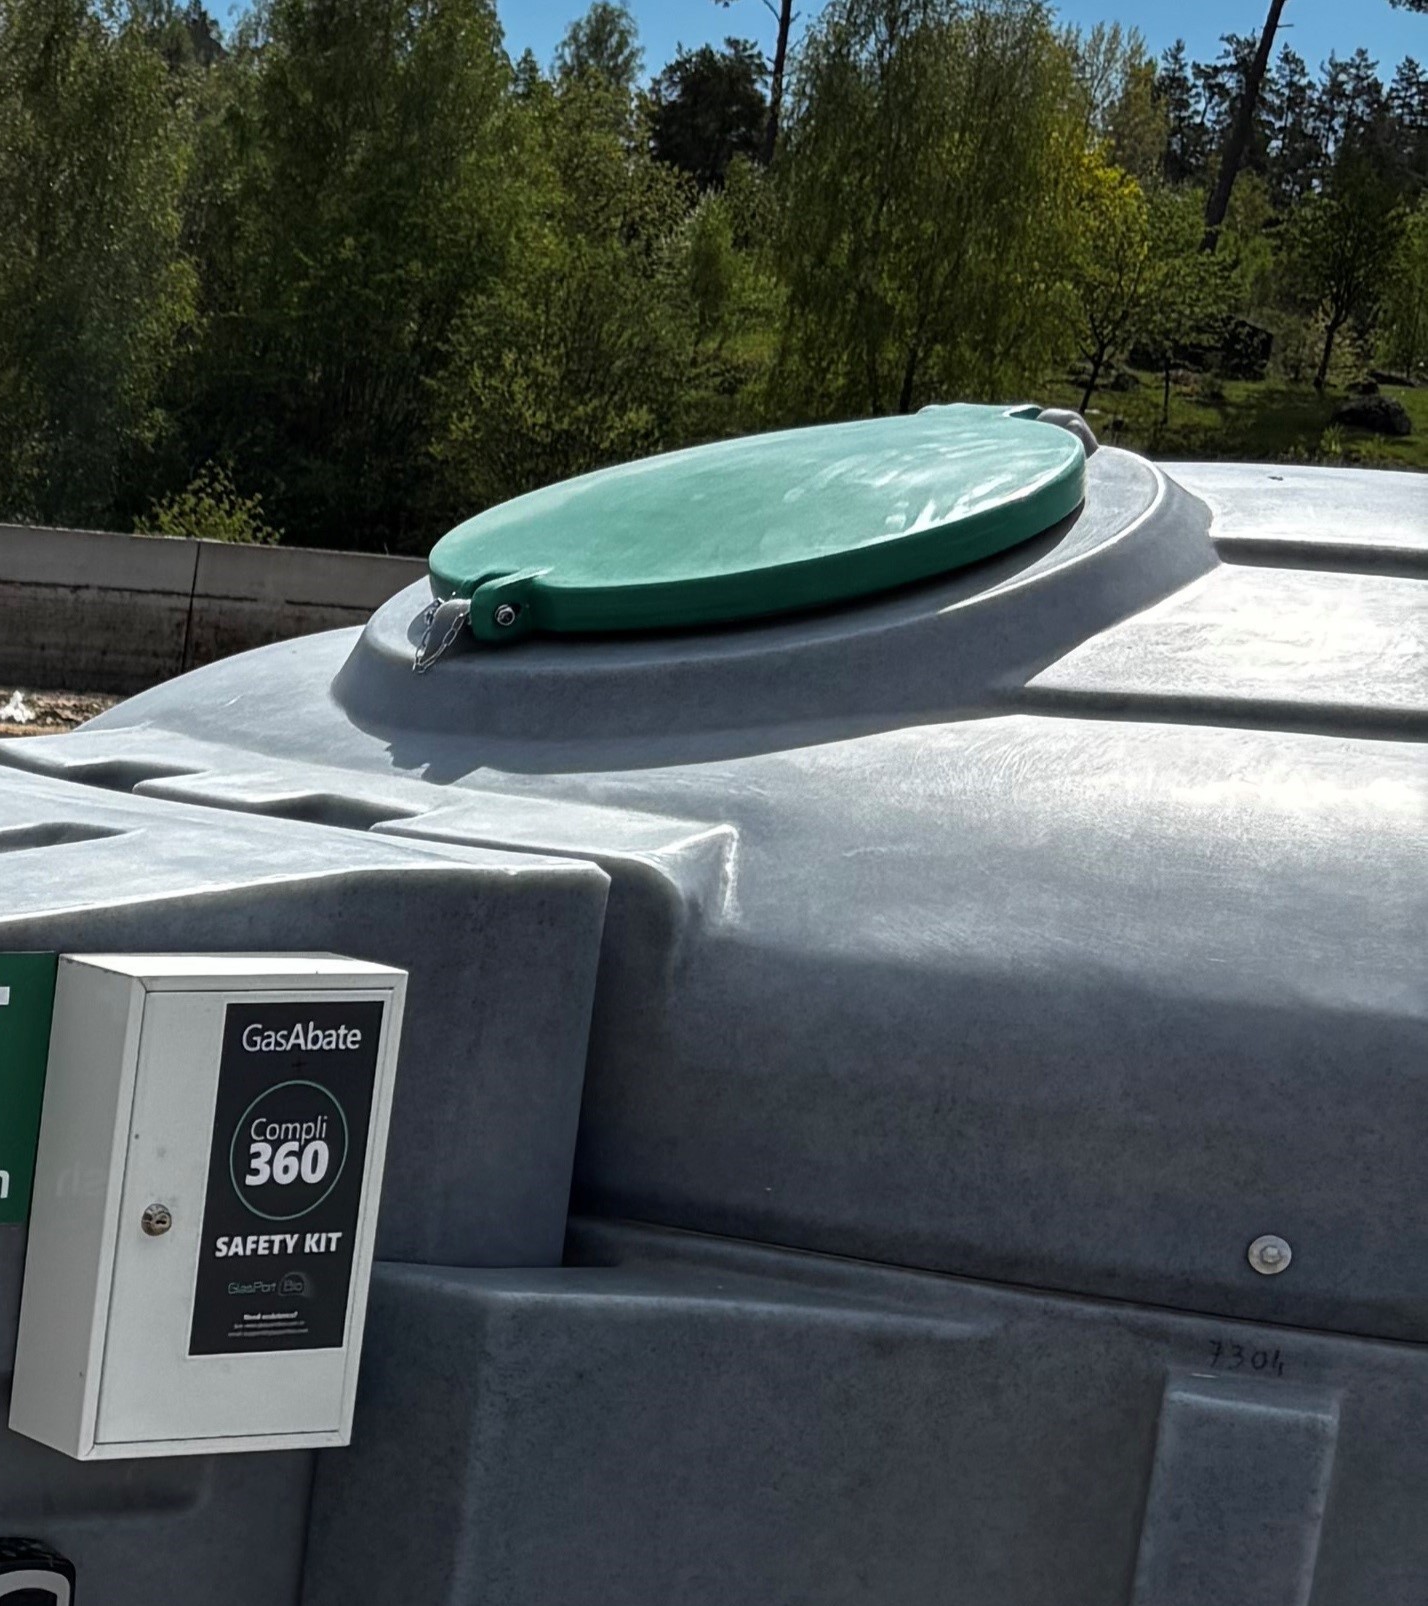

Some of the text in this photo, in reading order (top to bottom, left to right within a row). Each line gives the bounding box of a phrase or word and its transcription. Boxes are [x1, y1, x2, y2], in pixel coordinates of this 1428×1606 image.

[242, 1021, 362, 1052] GasAbate
[250, 1115, 328, 1146] Compli
[245, 1140, 329, 1186] 360
[214, 1231, 343, 1257] SAFETY KIT
